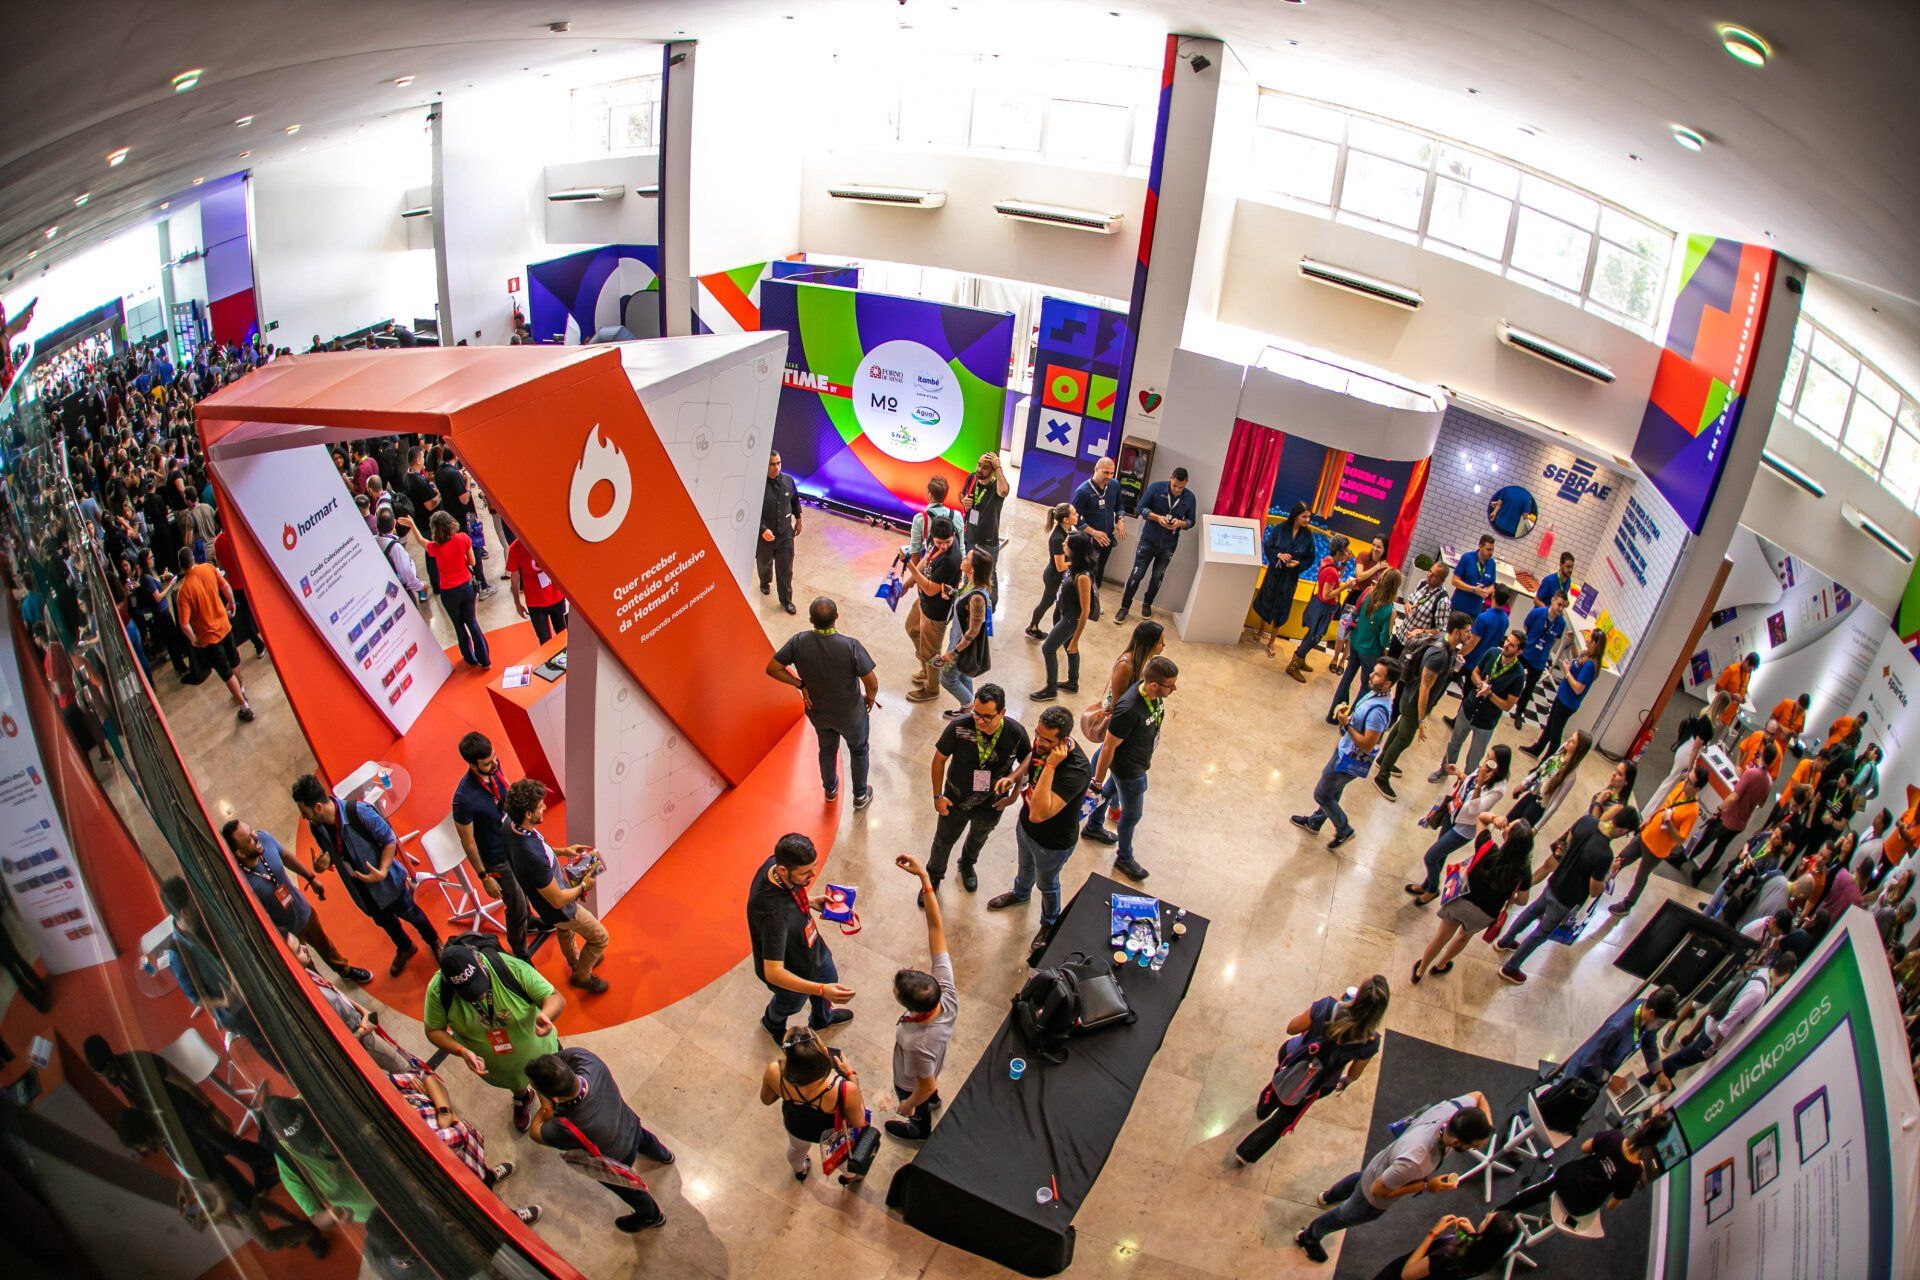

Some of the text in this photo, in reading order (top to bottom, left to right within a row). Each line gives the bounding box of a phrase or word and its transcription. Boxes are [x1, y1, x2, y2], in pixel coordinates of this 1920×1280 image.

[882, 368, 904, 378] FORNO
[1707, 272, 1760, 461] ENTREPRENEURSHIP
[891, 431, 918, 442] SNACK
[1543, 464, 1612, 501] SEBRAE
[297, 497, 338, 537] hotmart
[310, 562, 324, 577] Cards
[613, 551, 677, 600] Quer receber
[616, 549, 706, 617] conteúdo exclusivo
[619, 582, 679, 633] da Hotmart?
[640, 582, 716, 643] Responda nossa pesquisa!
[1888, 678, 1908, 708] sparkle
[450, 963, 476, 985] BROGA
[1729, 994, 1833, 1103] klickpages
